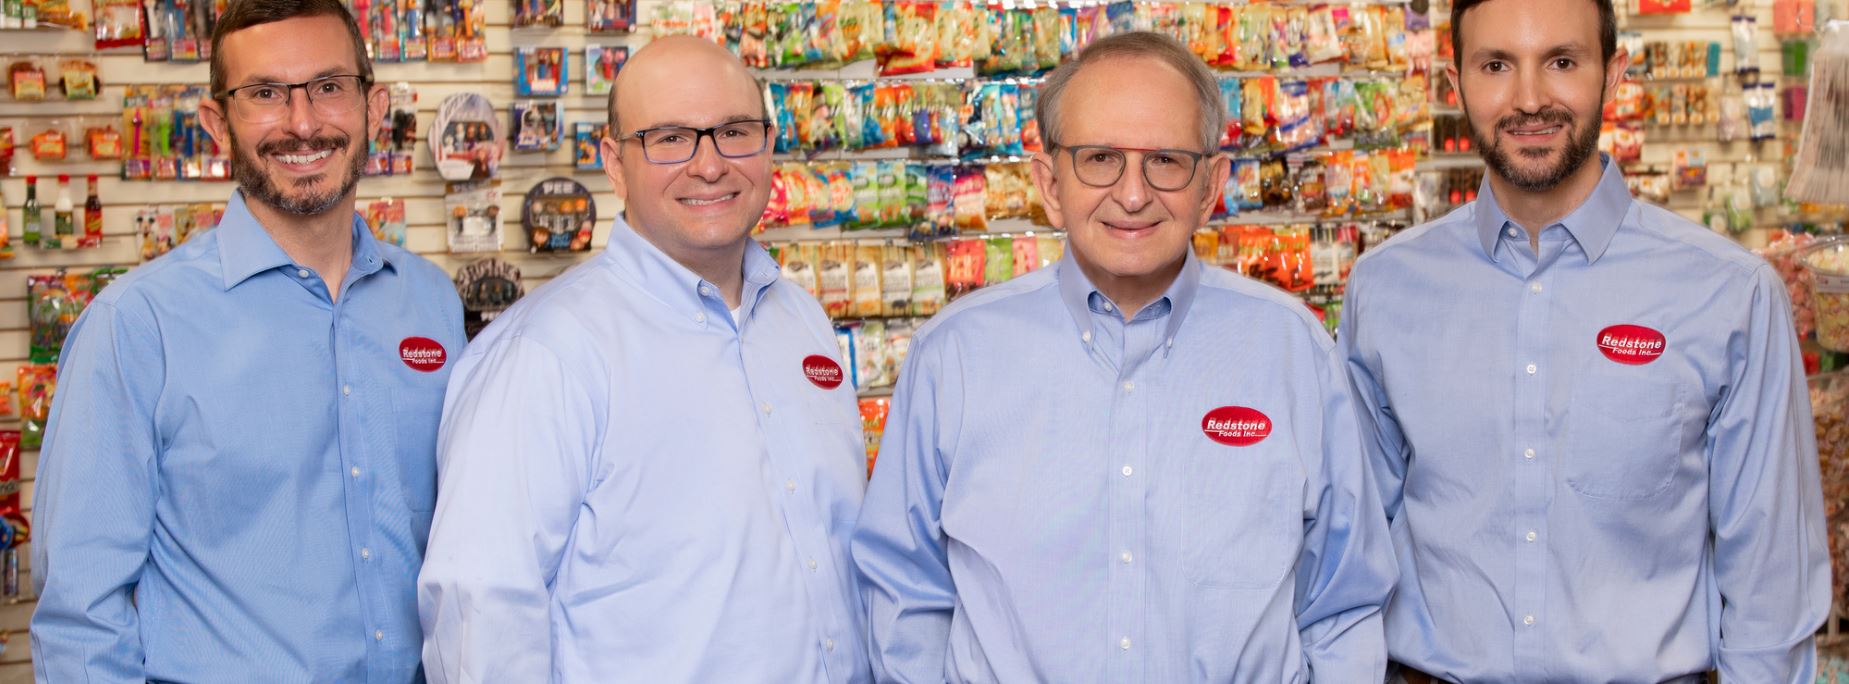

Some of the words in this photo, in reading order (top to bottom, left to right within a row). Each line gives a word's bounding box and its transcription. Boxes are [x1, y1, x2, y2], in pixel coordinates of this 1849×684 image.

[1602, 335, 1662, 349] Redstone
[402, 347, 442, 358] Redstone
[1612, 347, 1636, 356] Foods
[805, 365, 839, 376] Redstone
[1207, 418, 1266, 430] Redstone
